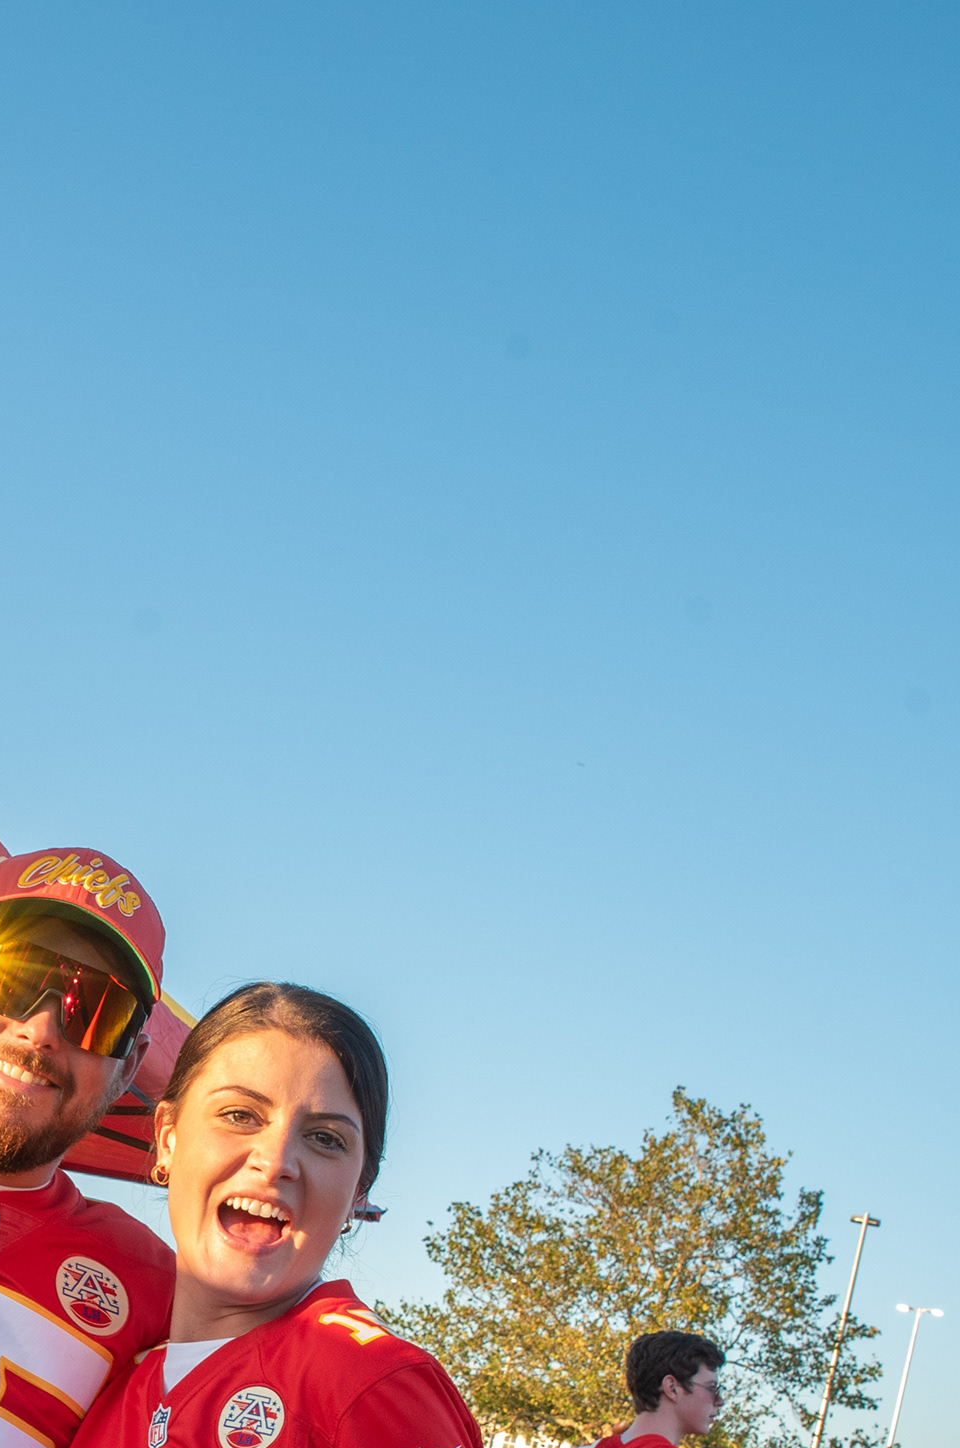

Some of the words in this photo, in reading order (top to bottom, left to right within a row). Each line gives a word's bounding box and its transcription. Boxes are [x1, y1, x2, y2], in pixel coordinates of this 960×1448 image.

[17, 853, 141, 917] Chiefs
[83, 1306, 101, 1322] LH
[237, 1434, 253, 1446] LH
